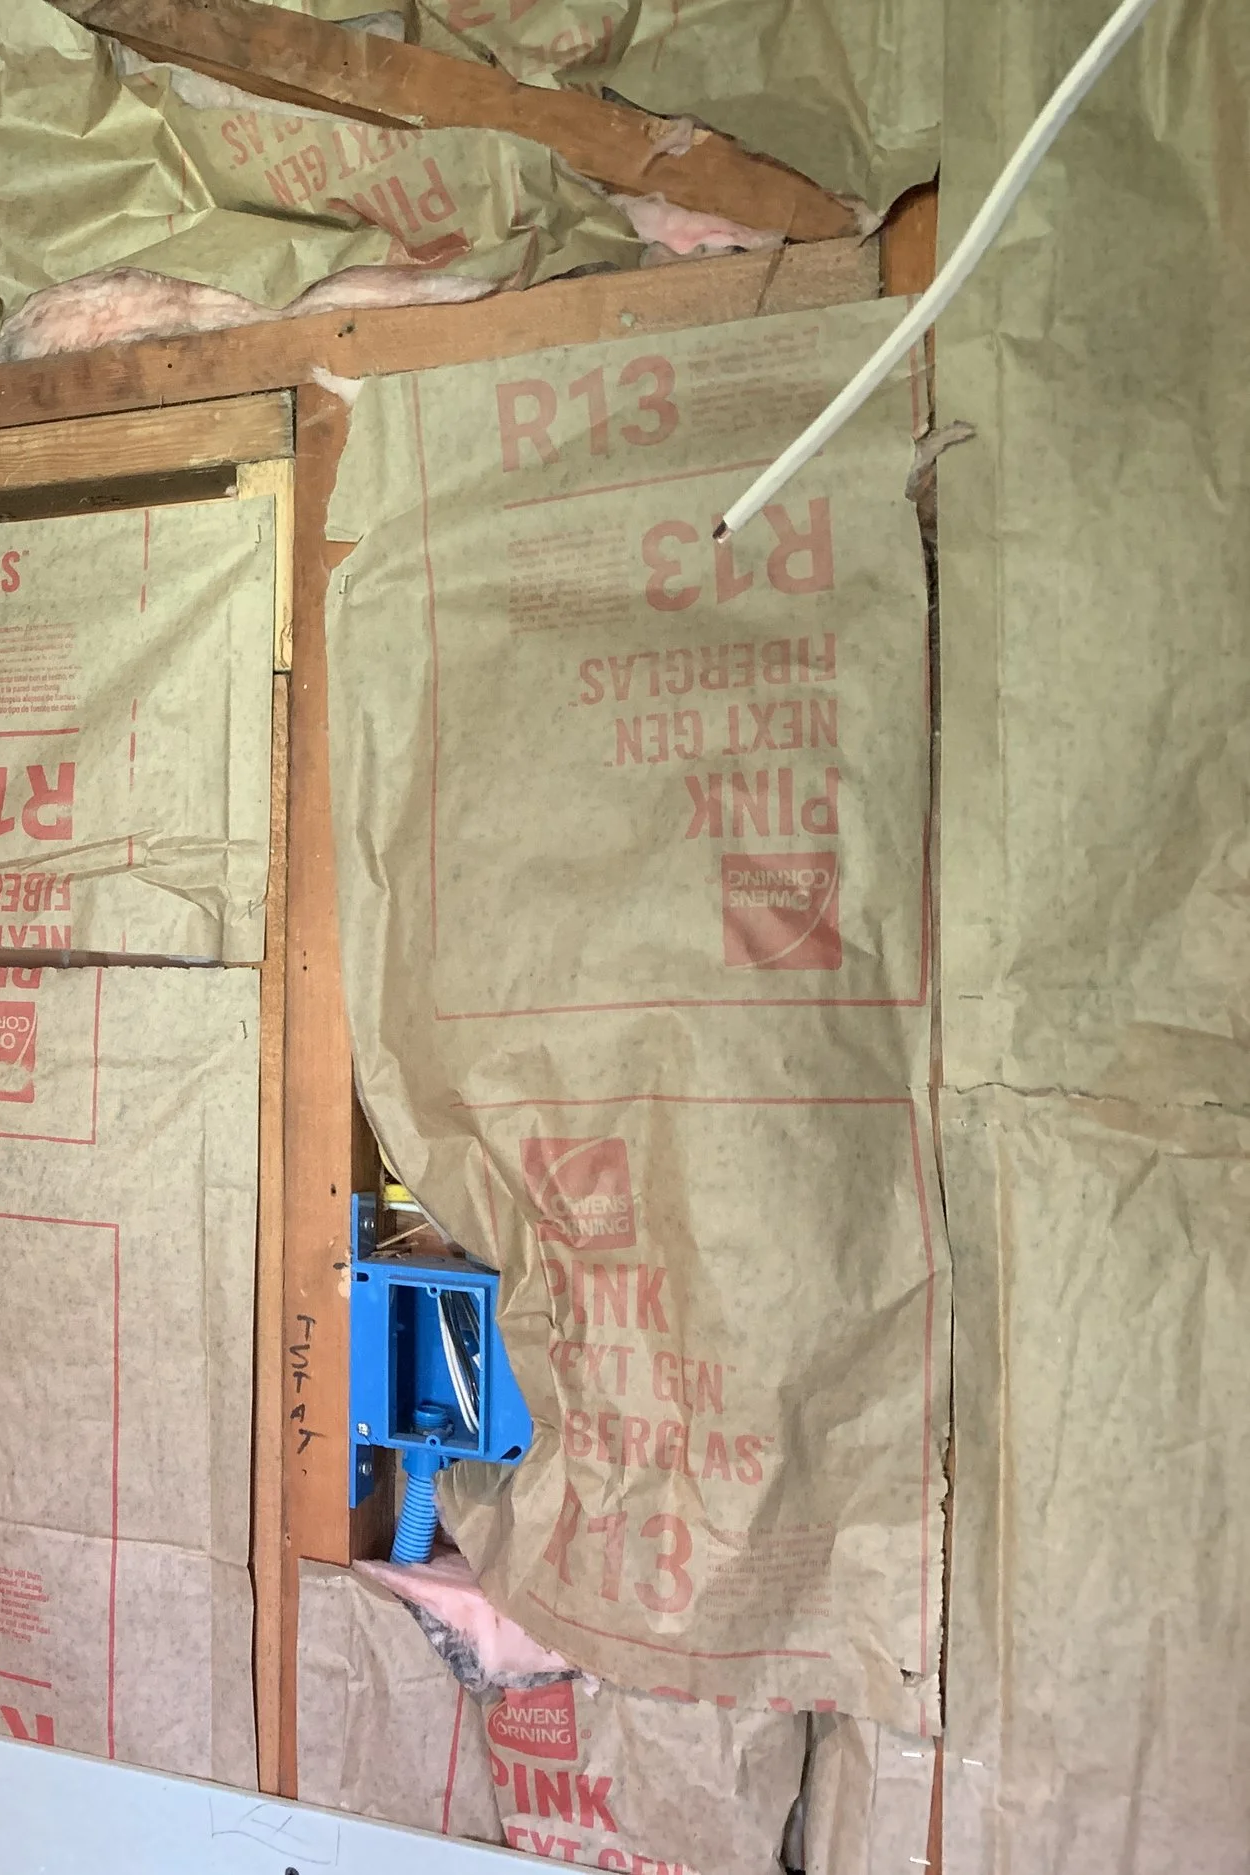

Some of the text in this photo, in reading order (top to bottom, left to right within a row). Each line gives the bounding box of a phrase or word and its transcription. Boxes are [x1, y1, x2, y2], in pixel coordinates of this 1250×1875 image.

[264, 144, 327, 207] GEN
[495, 354, 679, 473] R13
[641, 496, 836, 613] R13
[579, 632, 838, 706] FIBERGLAS
[614, 698, 839, 767] NEXT GEN
[684, 766, 840, 840] PINK
[728, 868, 830, 889] CORNING
[550, 1194, 628, 1220] OWENS
[548, 1340, 723, 1415] EXT GEN
[564, 1408, 763, 1486] BERGLAS
[489, 1748, 618, 1833] PINK
